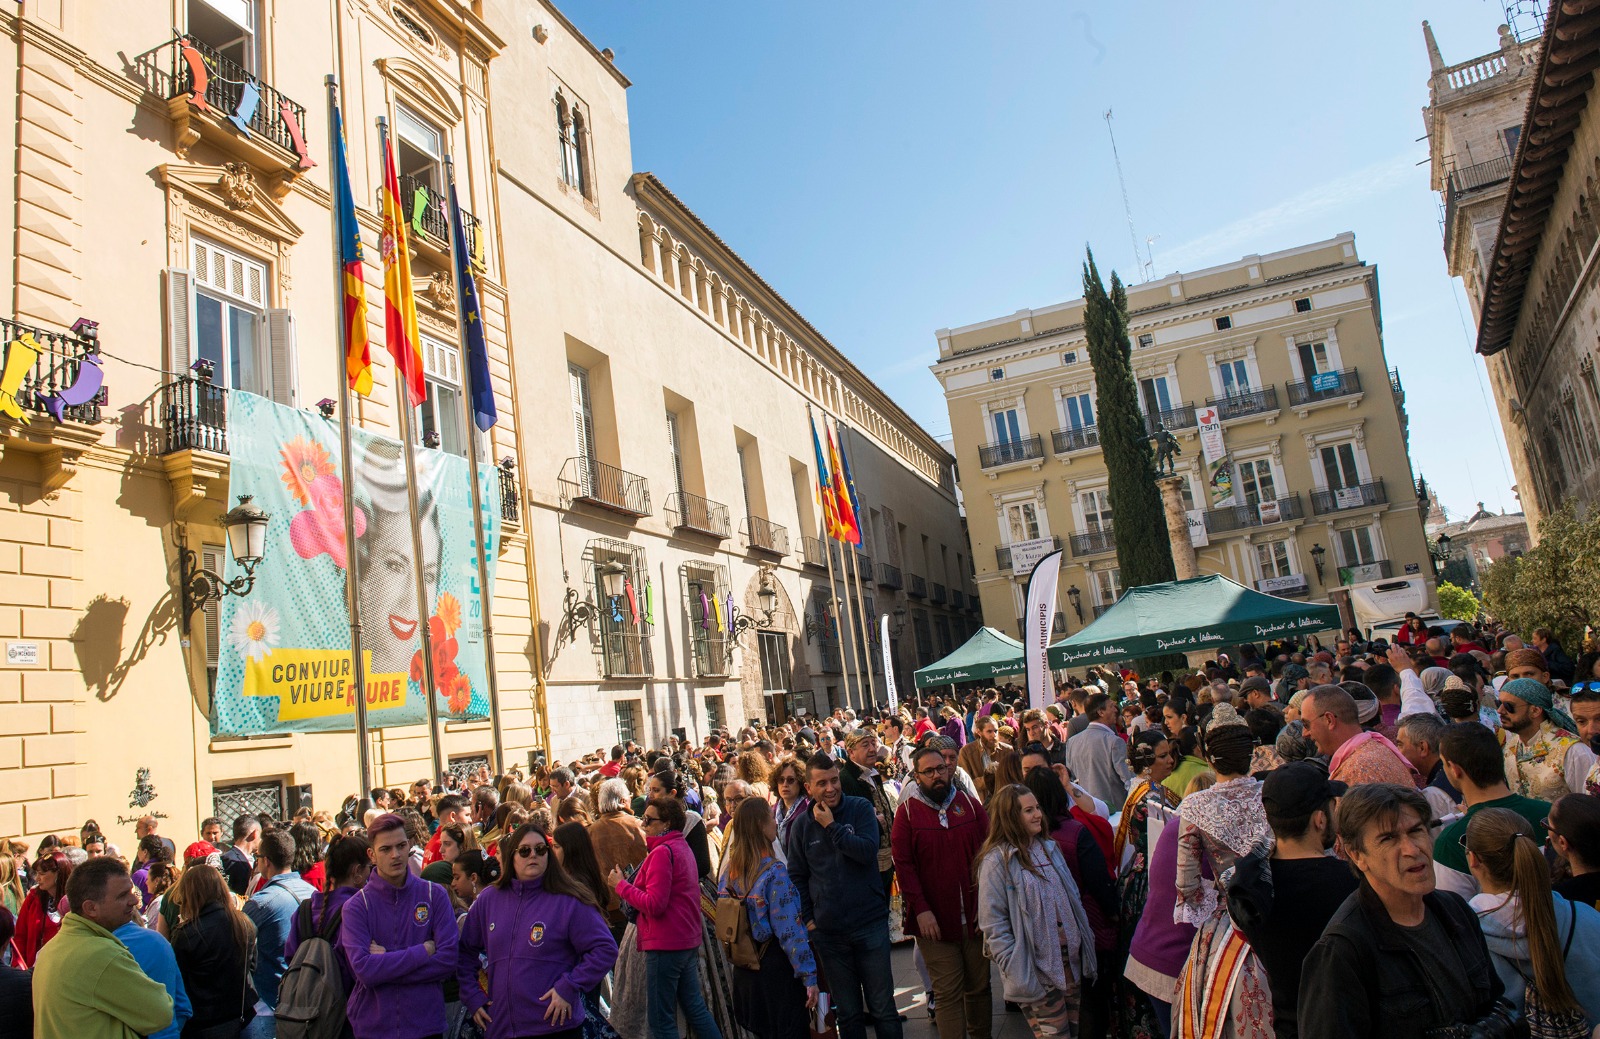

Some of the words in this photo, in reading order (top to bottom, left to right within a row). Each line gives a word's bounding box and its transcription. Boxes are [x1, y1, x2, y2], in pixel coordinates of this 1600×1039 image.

[1201, 423, 1220, 433] rsm
[1039, 603, 1047, 650] MUNICIPIS
[272, 658, 353, 683] CONVIUR
[290, 679, 345, 704] VIURE
[346, 679, 401, 707] RURE
